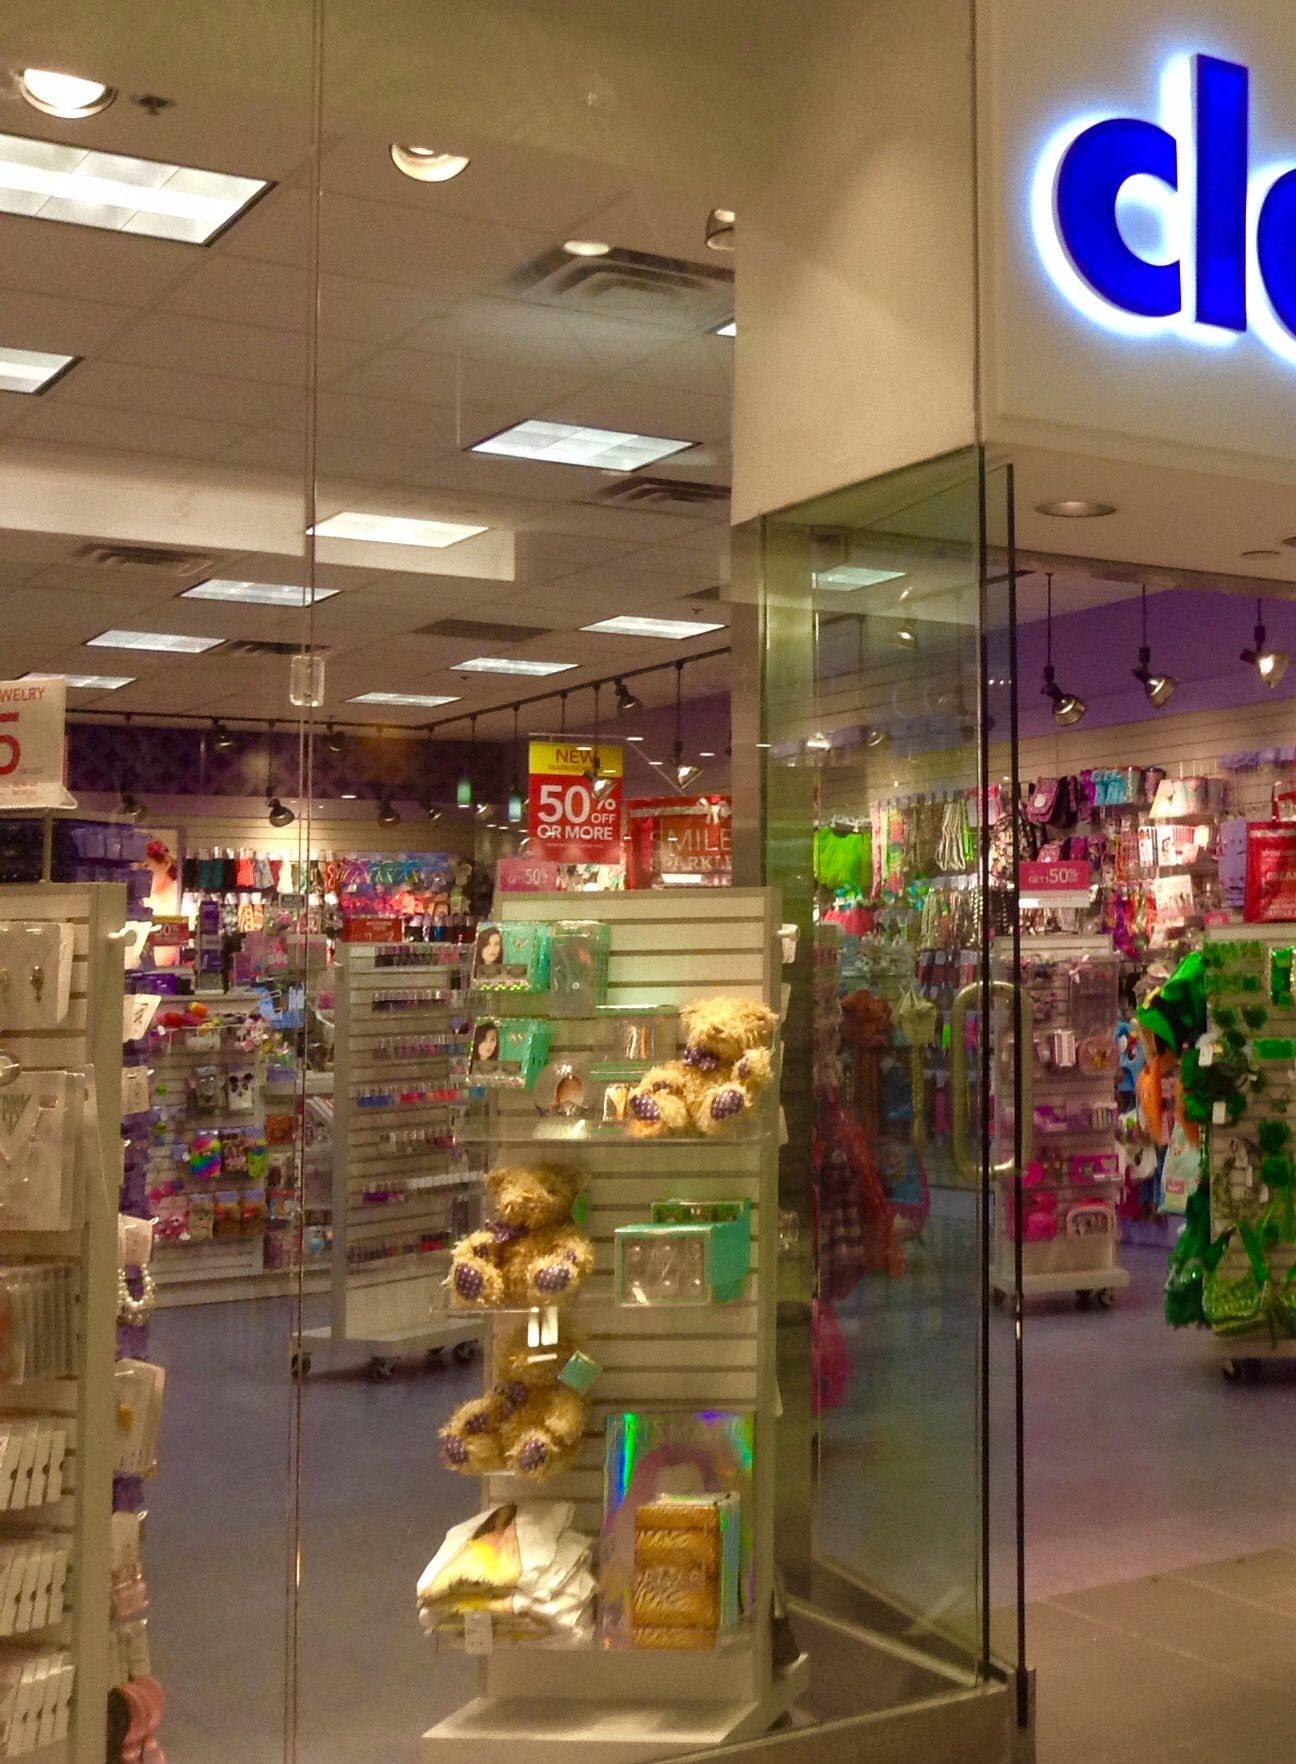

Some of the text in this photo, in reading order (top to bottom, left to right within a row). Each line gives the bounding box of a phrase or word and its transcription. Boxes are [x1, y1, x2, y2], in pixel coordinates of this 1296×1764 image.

[556, 749, 599, 764] NEW
[591, 813, 616, 825] OFF
[537, 824, 613, 840] OR MORE
